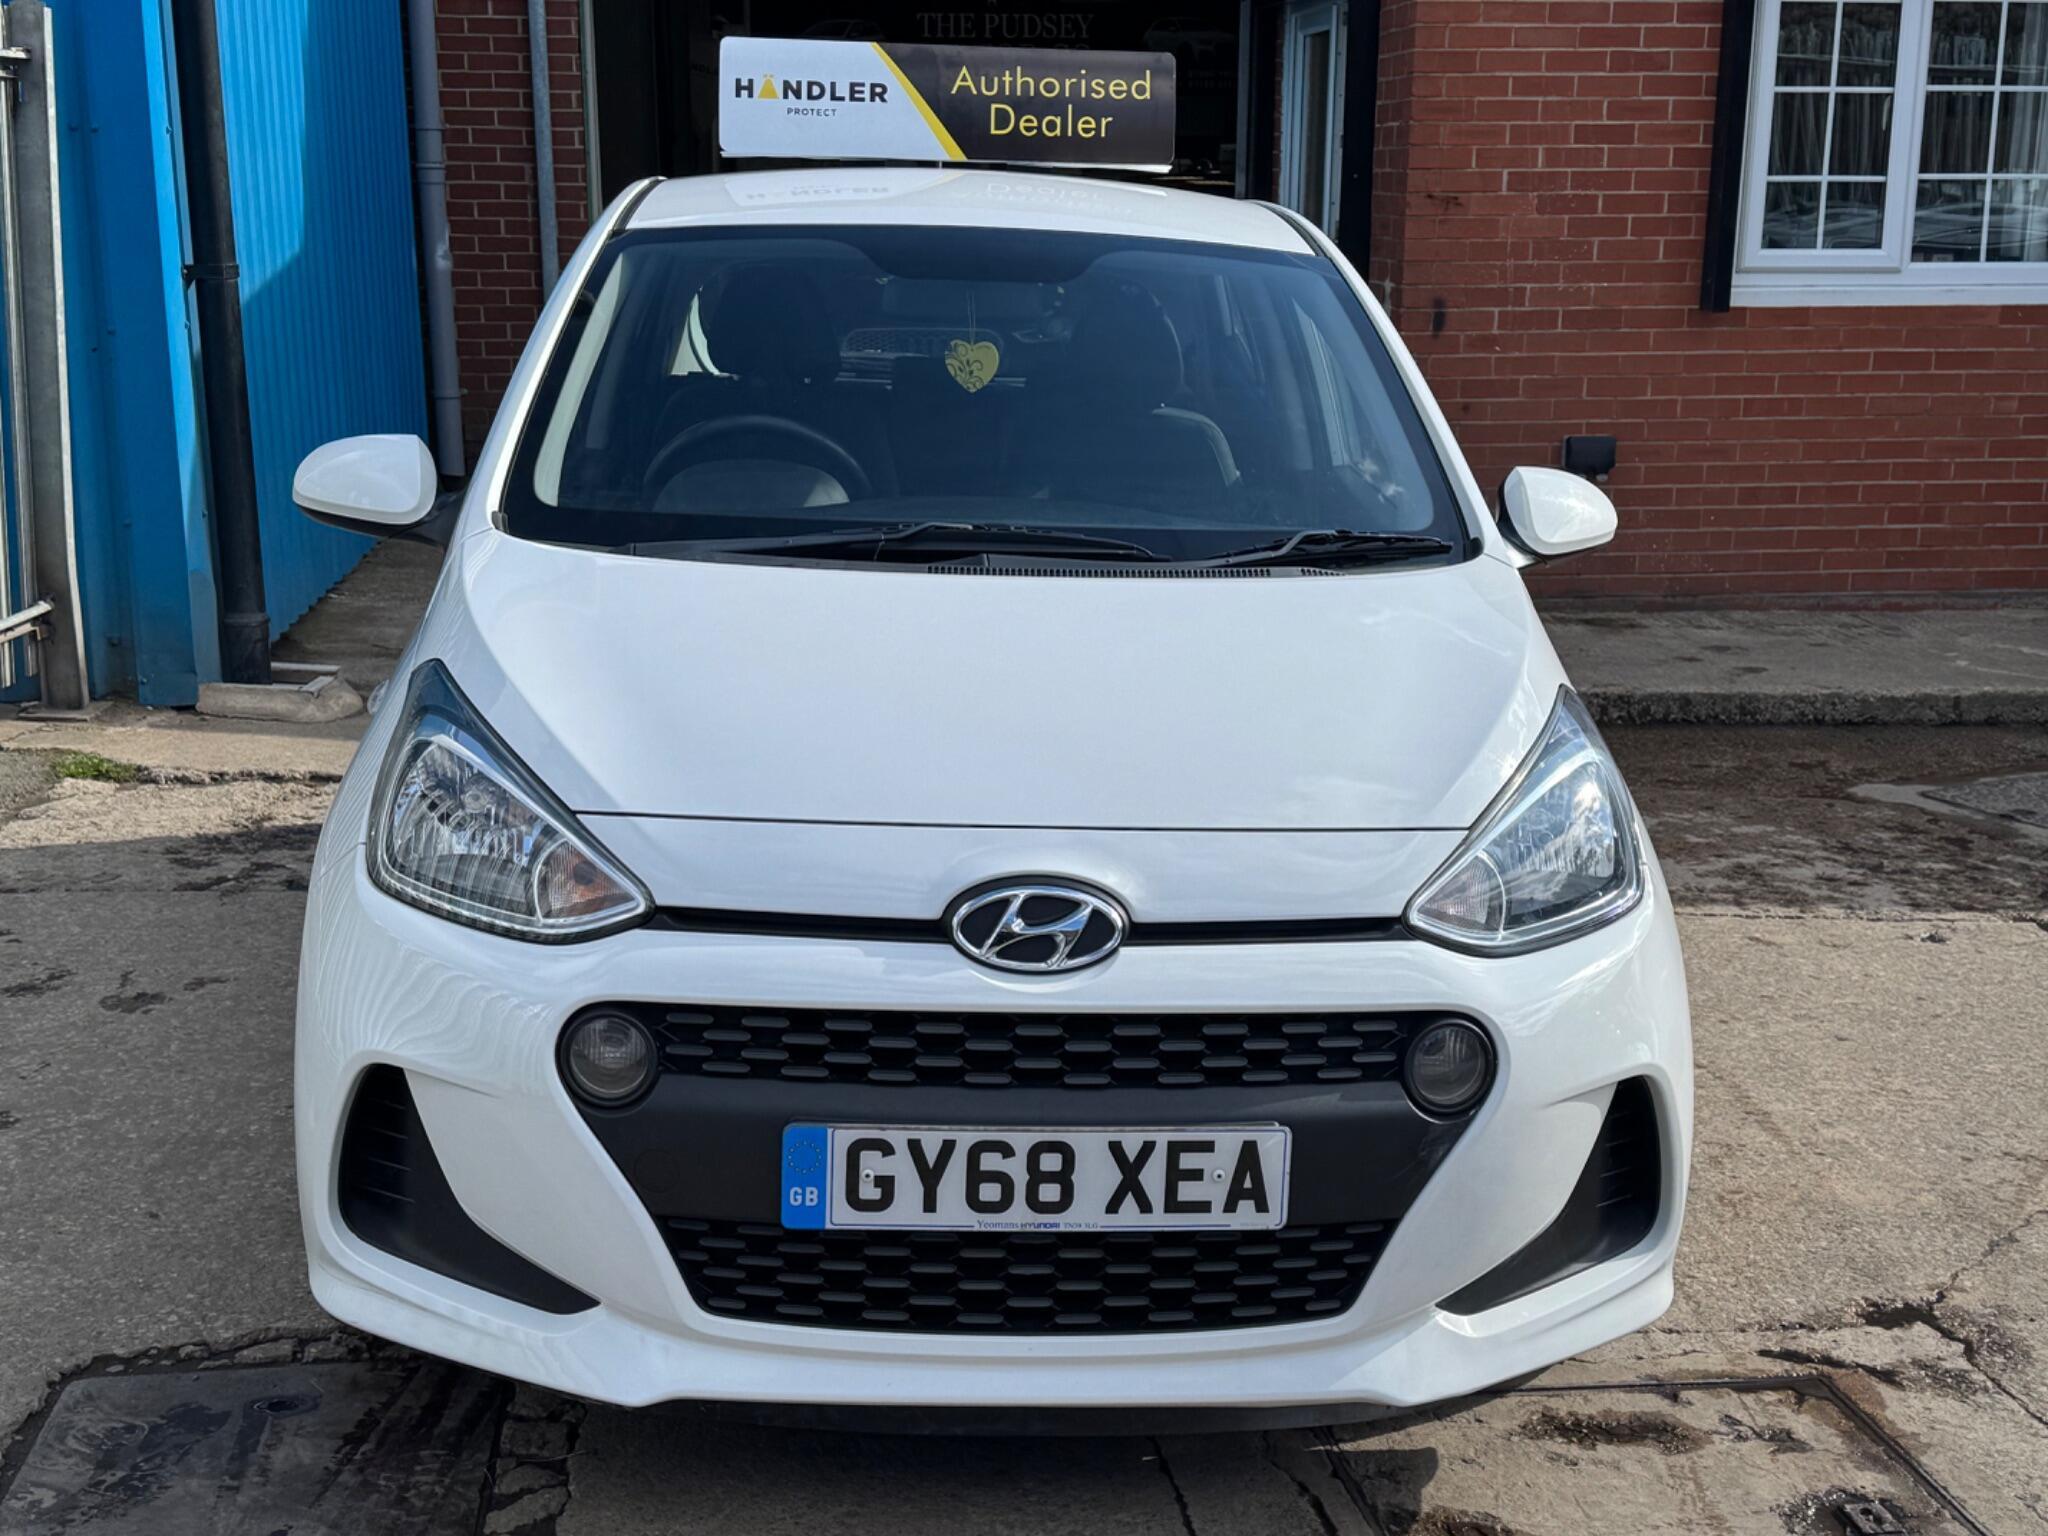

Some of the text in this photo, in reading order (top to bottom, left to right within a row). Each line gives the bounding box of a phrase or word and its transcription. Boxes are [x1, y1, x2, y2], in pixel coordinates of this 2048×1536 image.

[918, 13, 1095, 39] THE PUDSEY
[951, 65, 1151, 100] Authorised
[786, 107, 837, 117] PROTECT
[990, 103, 1113, 138] Dealer
[844, 1138, 1270, 1214] GY68 XEA
[789, 1186, 819, 1207] GB
[976, 1219, 1019, 1229] Yeomans
